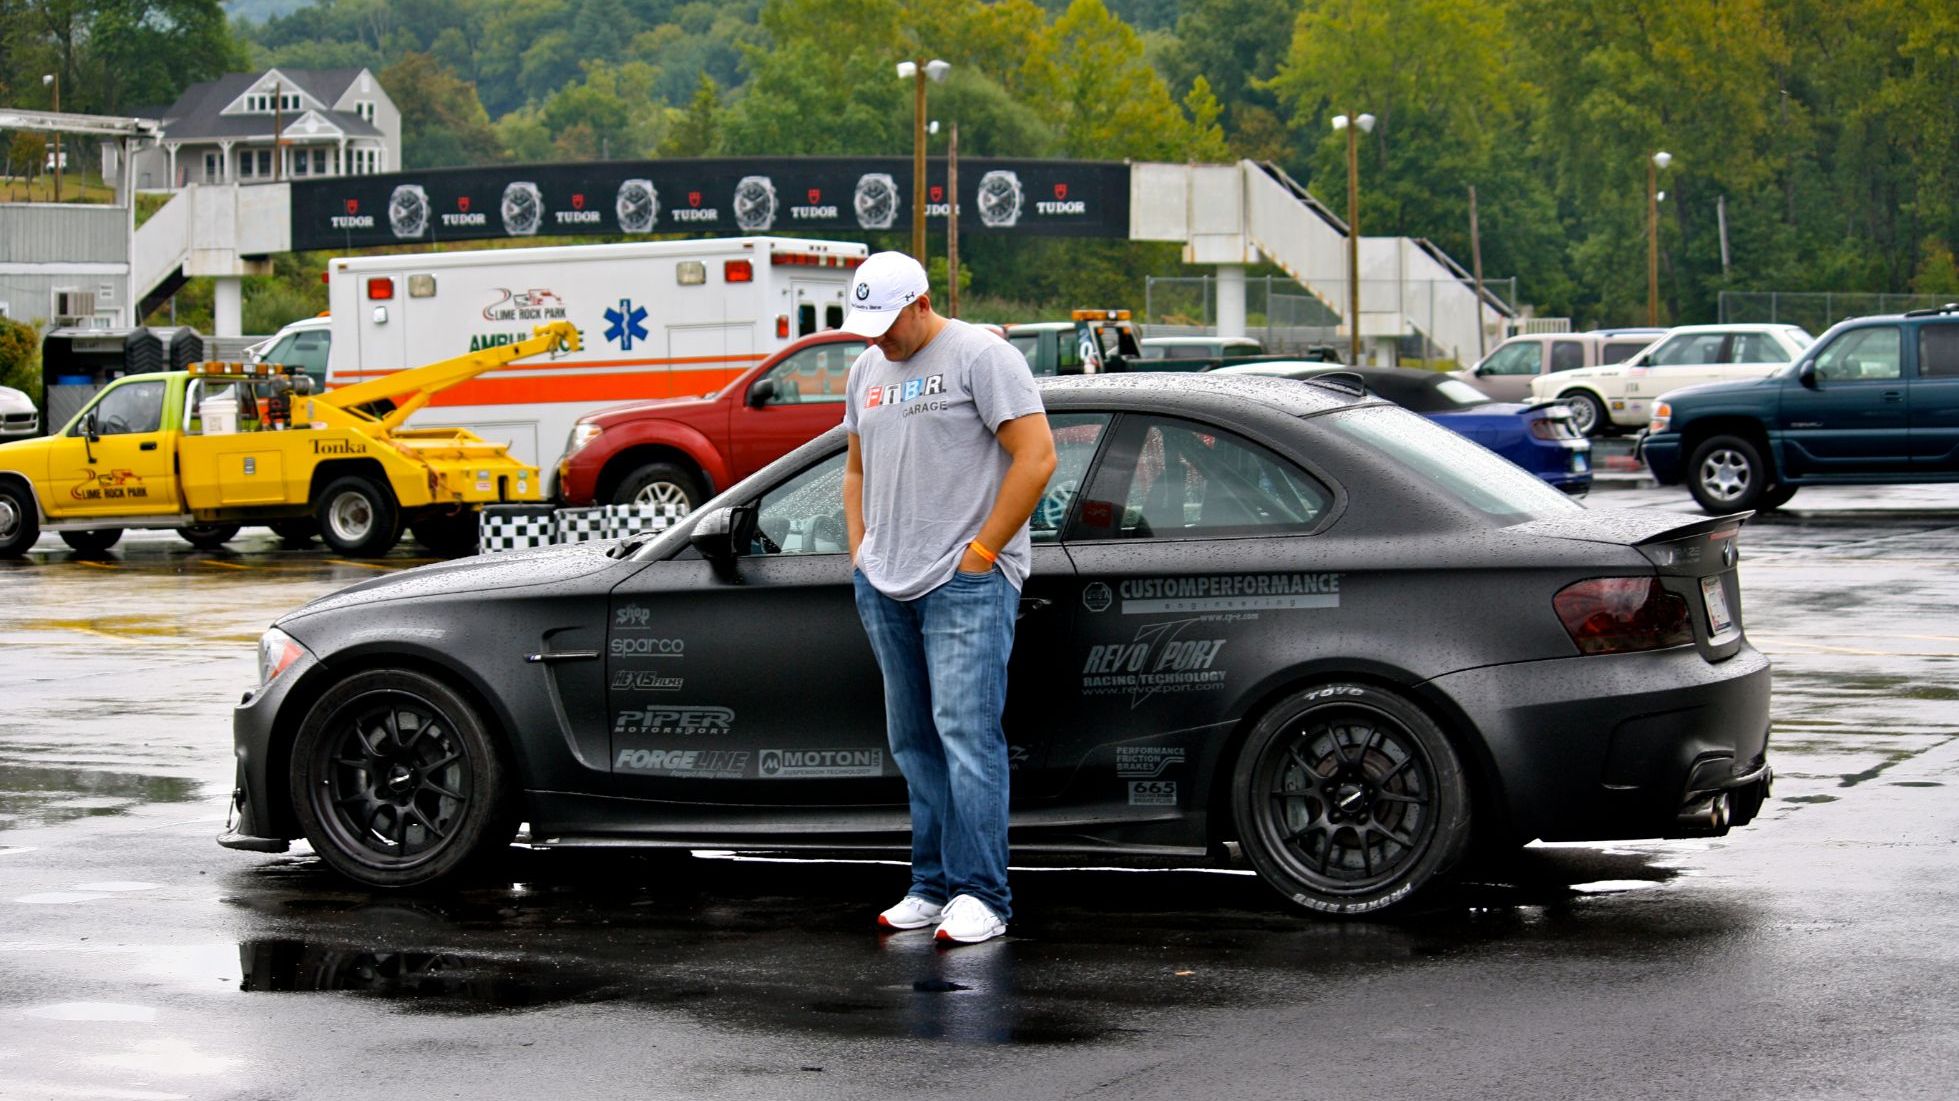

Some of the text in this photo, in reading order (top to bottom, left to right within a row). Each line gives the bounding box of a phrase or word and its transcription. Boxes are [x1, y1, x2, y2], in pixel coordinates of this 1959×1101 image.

[672, 207, 718, 221] TUDOR
[791, 205, 838, 219] TUDOR
[912, 204, 960, 216] UDO
[1036, 201, 1085, 214] TUDOR
[331, 215, 374, 229] TUDOR
[442, 213, 486, 227] TUDOR
[555, 210, 600, 224] TUDOR
[495, 307, 566, 321] LIME ROCK PARK
[903, 400, 949, 418] GARAGE
[309, 438, 367, 454] Tonka
[1119, 573, 1340, 599] CUSTOMPERFORMANCE
[611, 637, 684, 659] sparco
[1082, 670, 1227, 688] RACING TECHNOLOGY
[1304, 686, 1364, 701] TOYO
[614, 704, 735, 728] PIPER
[1116, 746, 1185, 755] PERFORMANCE
[783, 751, 871, 767] MOTON
[1116, 754, 1161, 763] FRICTION
[1116, 762, 1155, 771] BRAKES
[1134, 782, 1175, 794] 665
